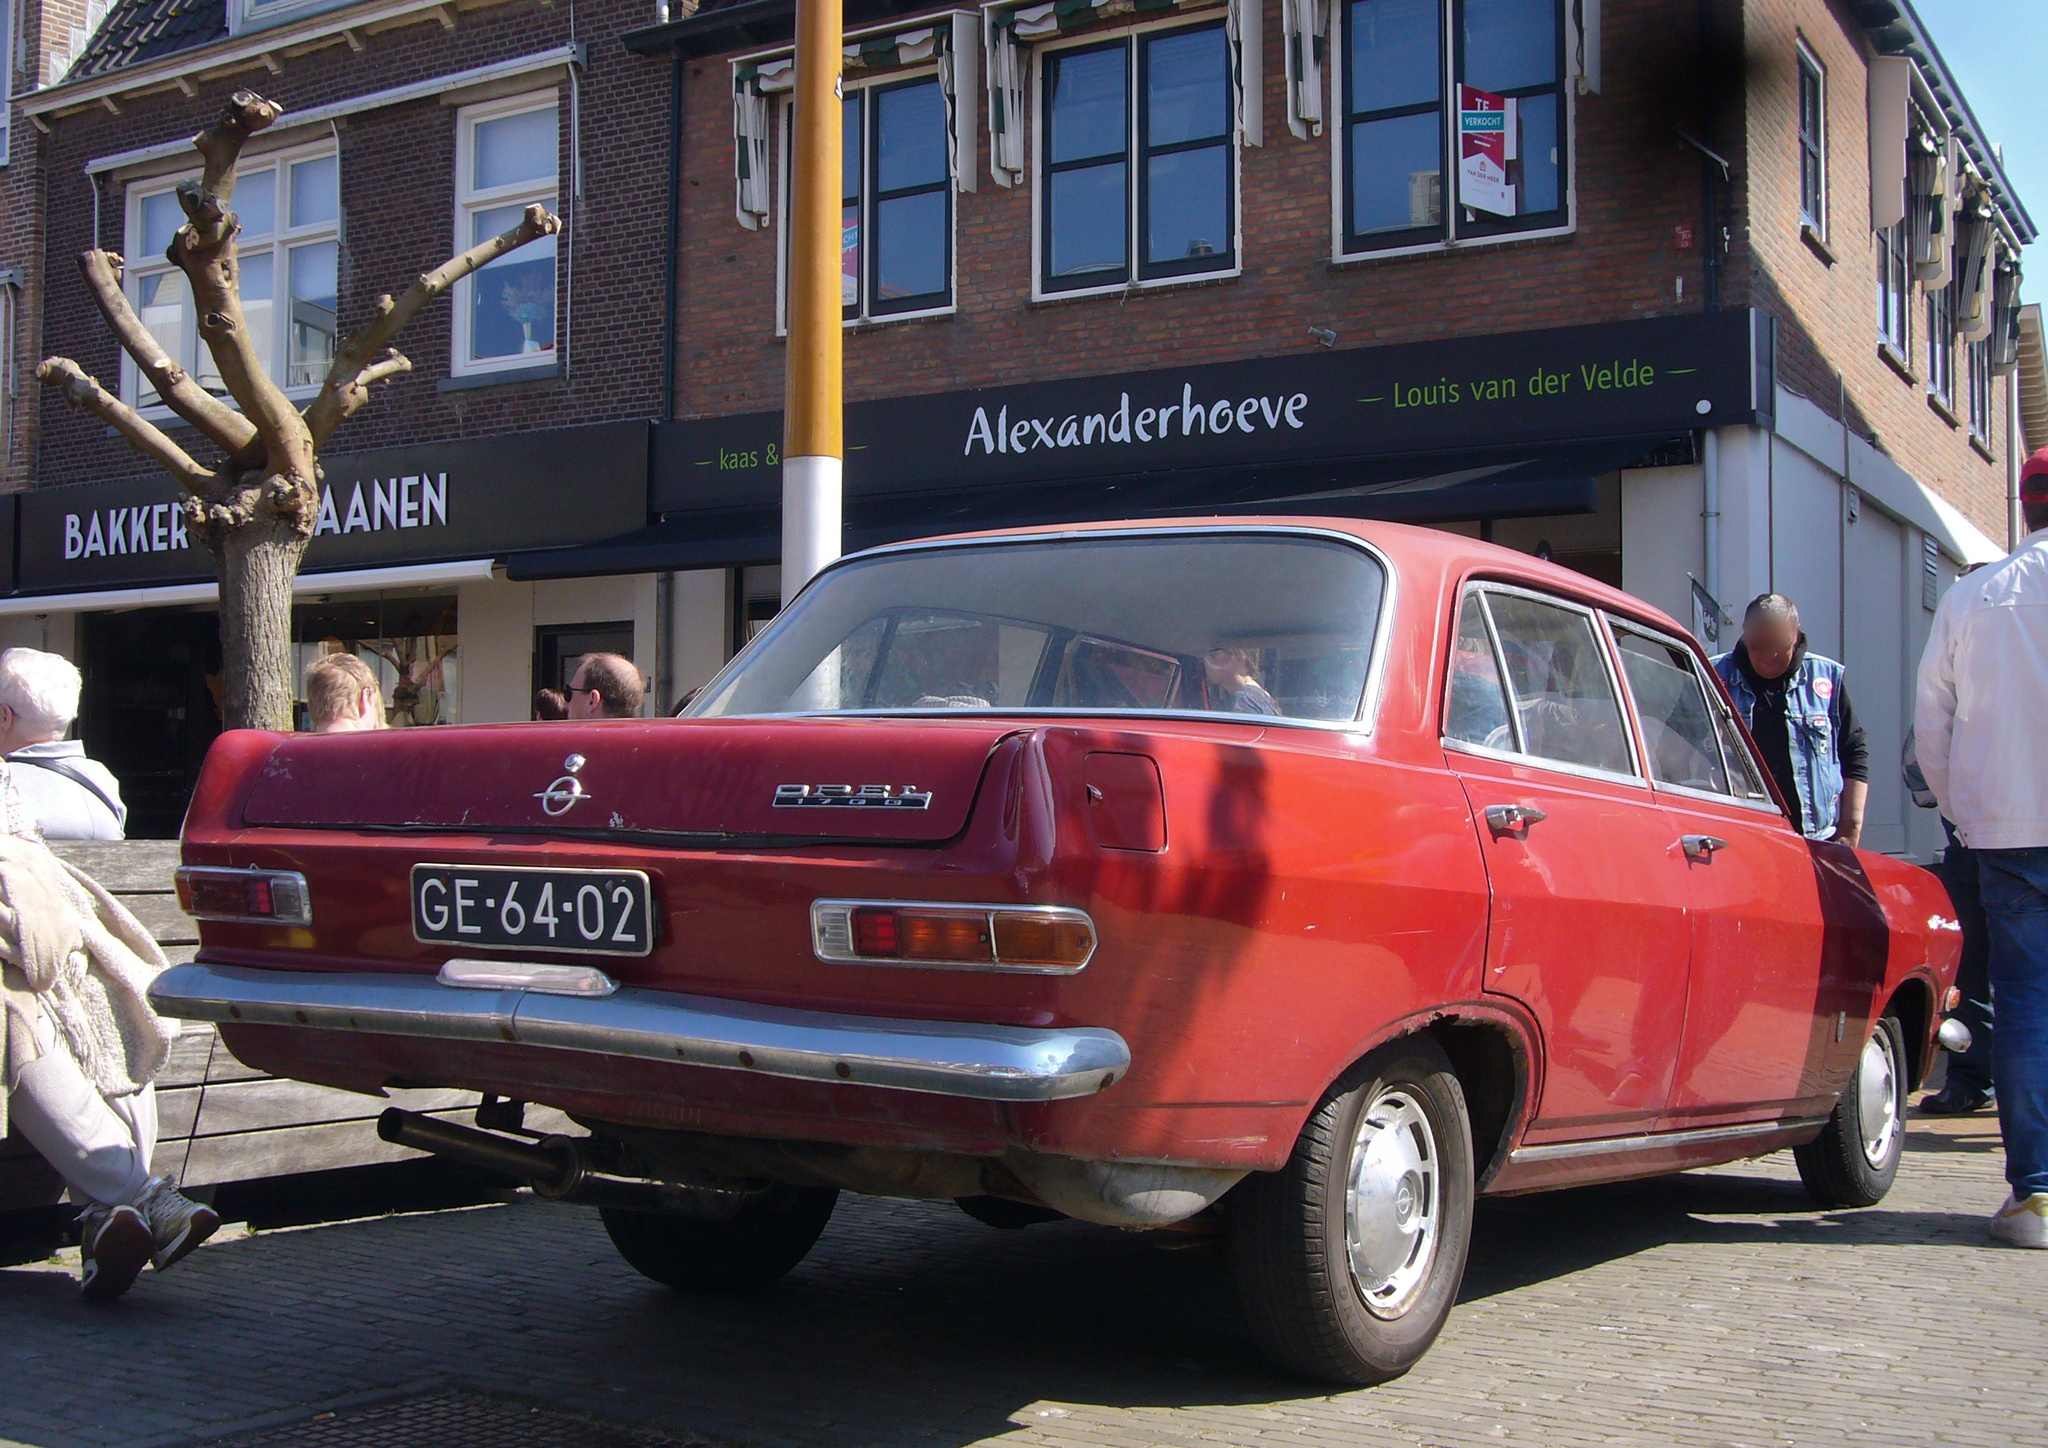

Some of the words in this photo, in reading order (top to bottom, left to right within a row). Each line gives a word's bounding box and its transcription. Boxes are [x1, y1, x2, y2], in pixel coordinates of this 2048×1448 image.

[1464, 116, 1501, 126] VERKOCHT
[1394, 377, 1460, 408] Louis
[1470, 377, 1516, 401] van
[1529, 368, 1570, 397] der
[1580, 359, 1655, 391] Velde
[964, 383, 1308, 456] Alexanderhoeve
[720, 448, 758, 470] kaas
[766, 443, 779, 466] &
[65, 502, 190, 560] BAKKER
